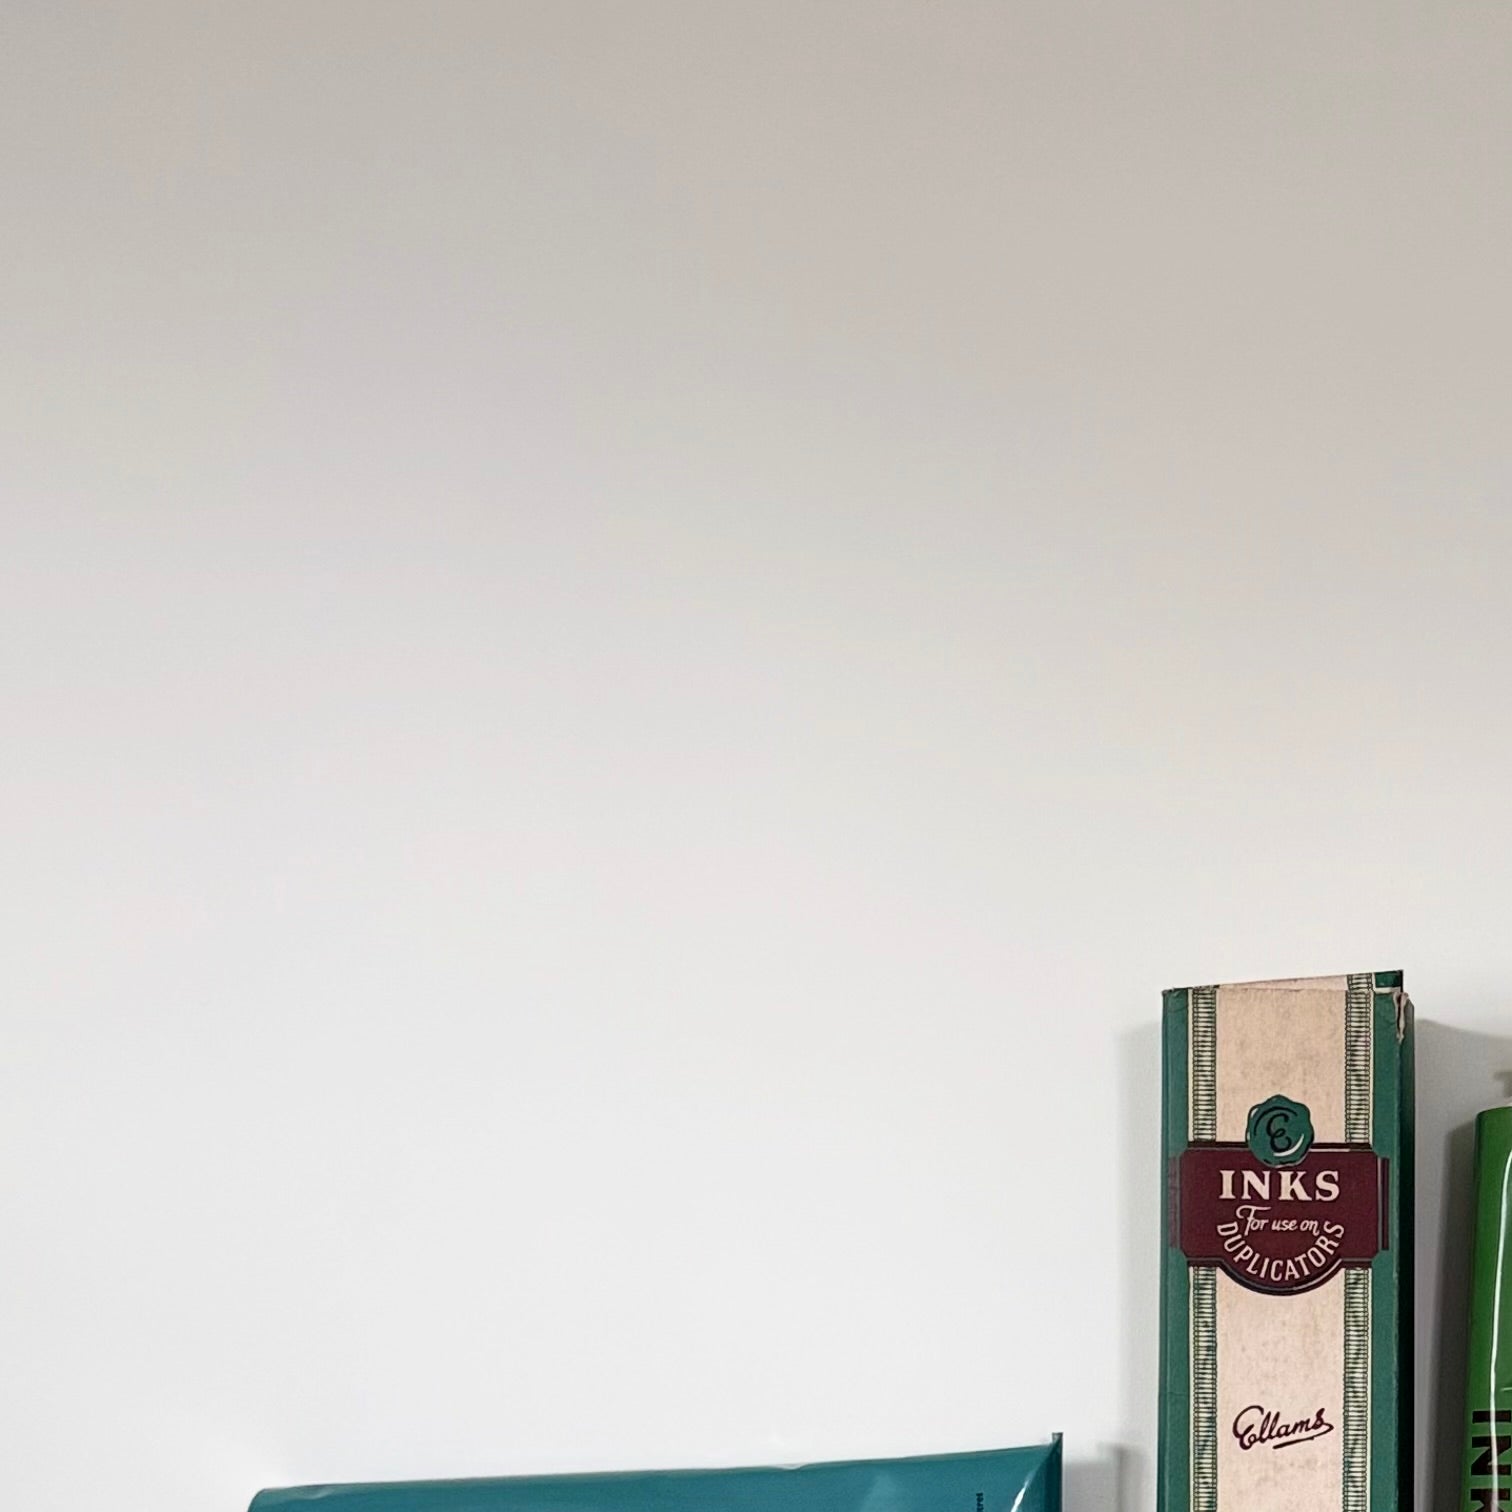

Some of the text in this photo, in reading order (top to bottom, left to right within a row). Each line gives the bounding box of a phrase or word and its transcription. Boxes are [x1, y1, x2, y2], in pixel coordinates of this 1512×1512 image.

[1218, 1169, 1341, 1202] INKS
[1235, 1203, 1322, 1236] For use on
[1216, 1220, 1346, 1282] DUPLICATORS
[1232, 1405, 1334, 1451] Ellams
